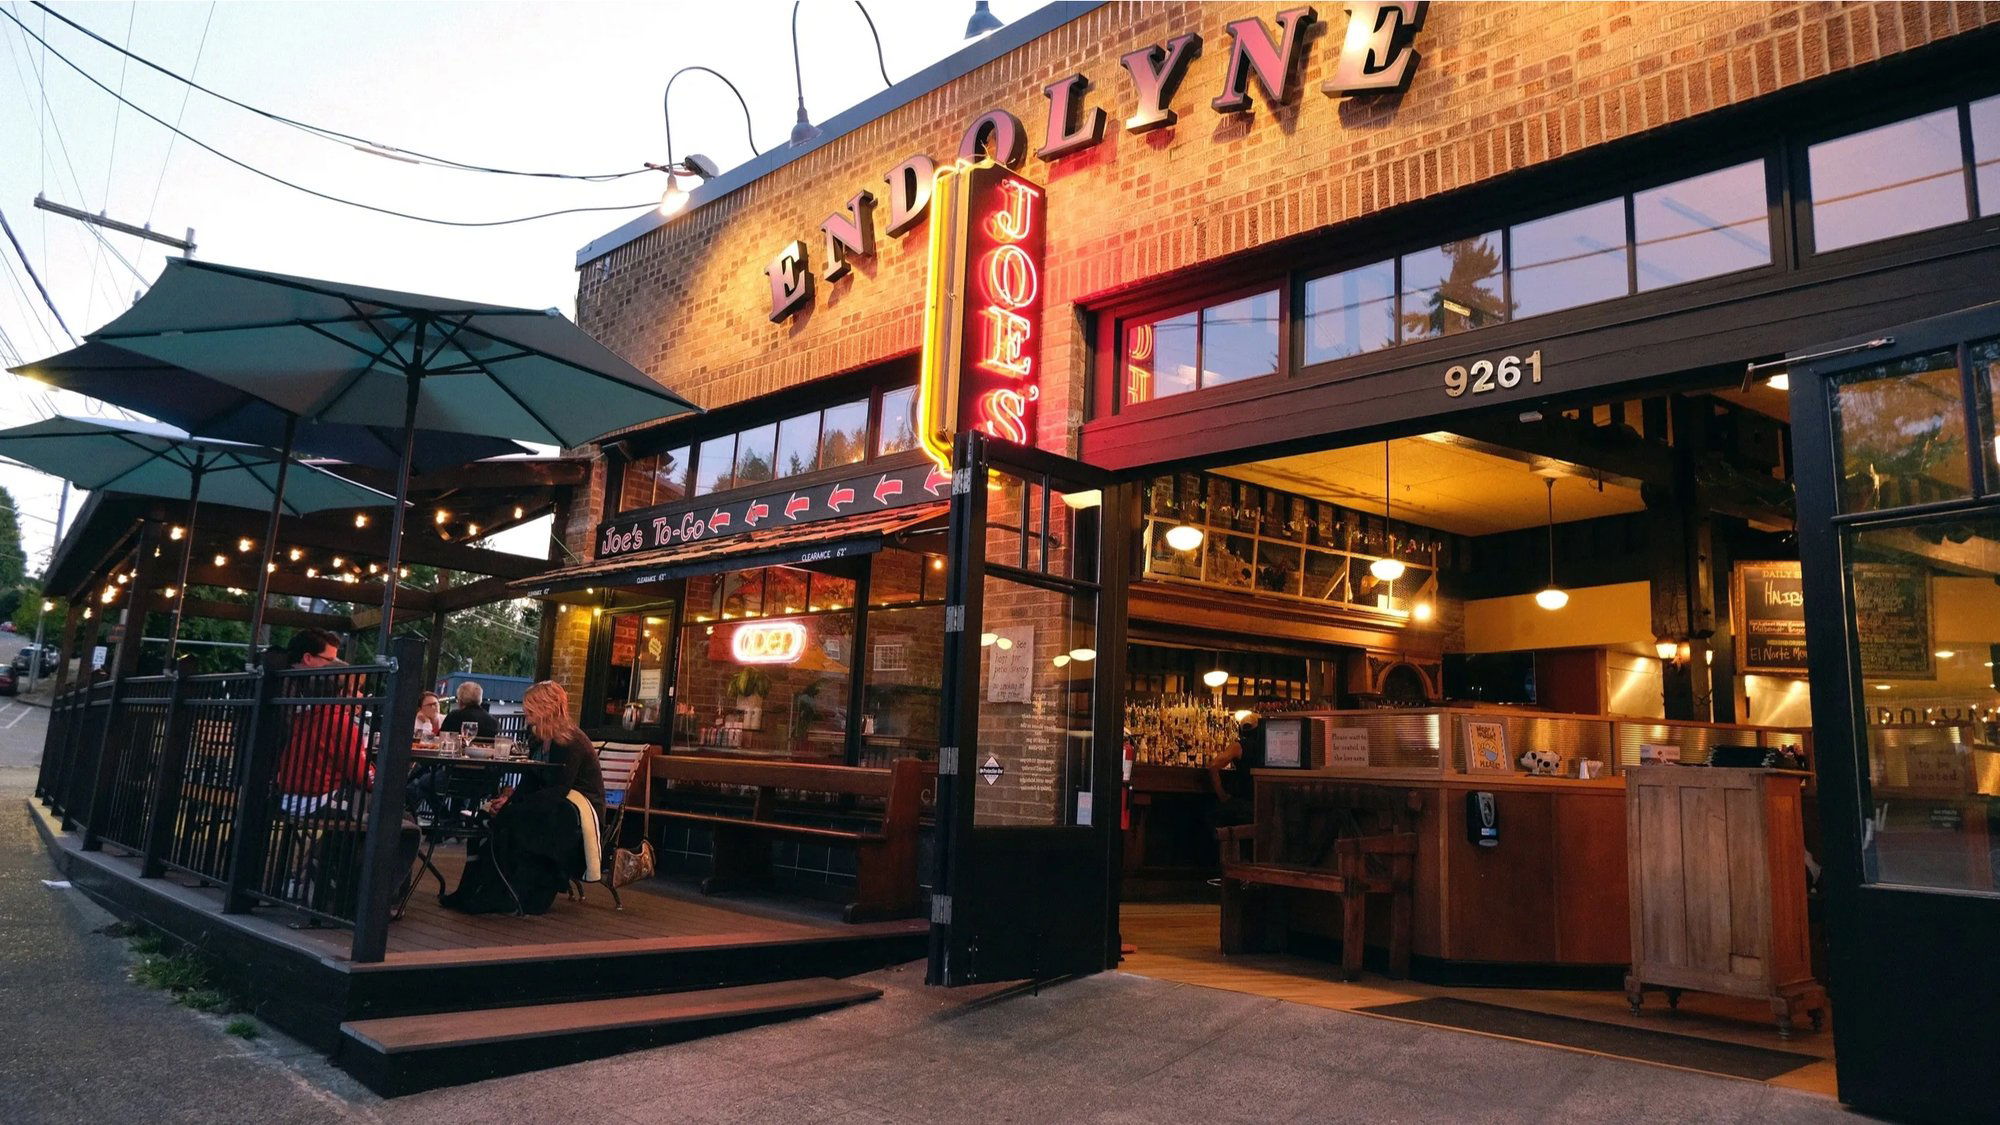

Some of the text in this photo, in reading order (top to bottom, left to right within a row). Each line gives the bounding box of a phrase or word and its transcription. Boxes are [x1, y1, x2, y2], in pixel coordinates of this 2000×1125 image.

[764, 1, 1427, 324] ENDOLYNE
[1444, 350, 1541, 397] 9261
[601, 512, 704, 554] Joe's To-Go
[801, 550, 831, 562] CLEARANCE
